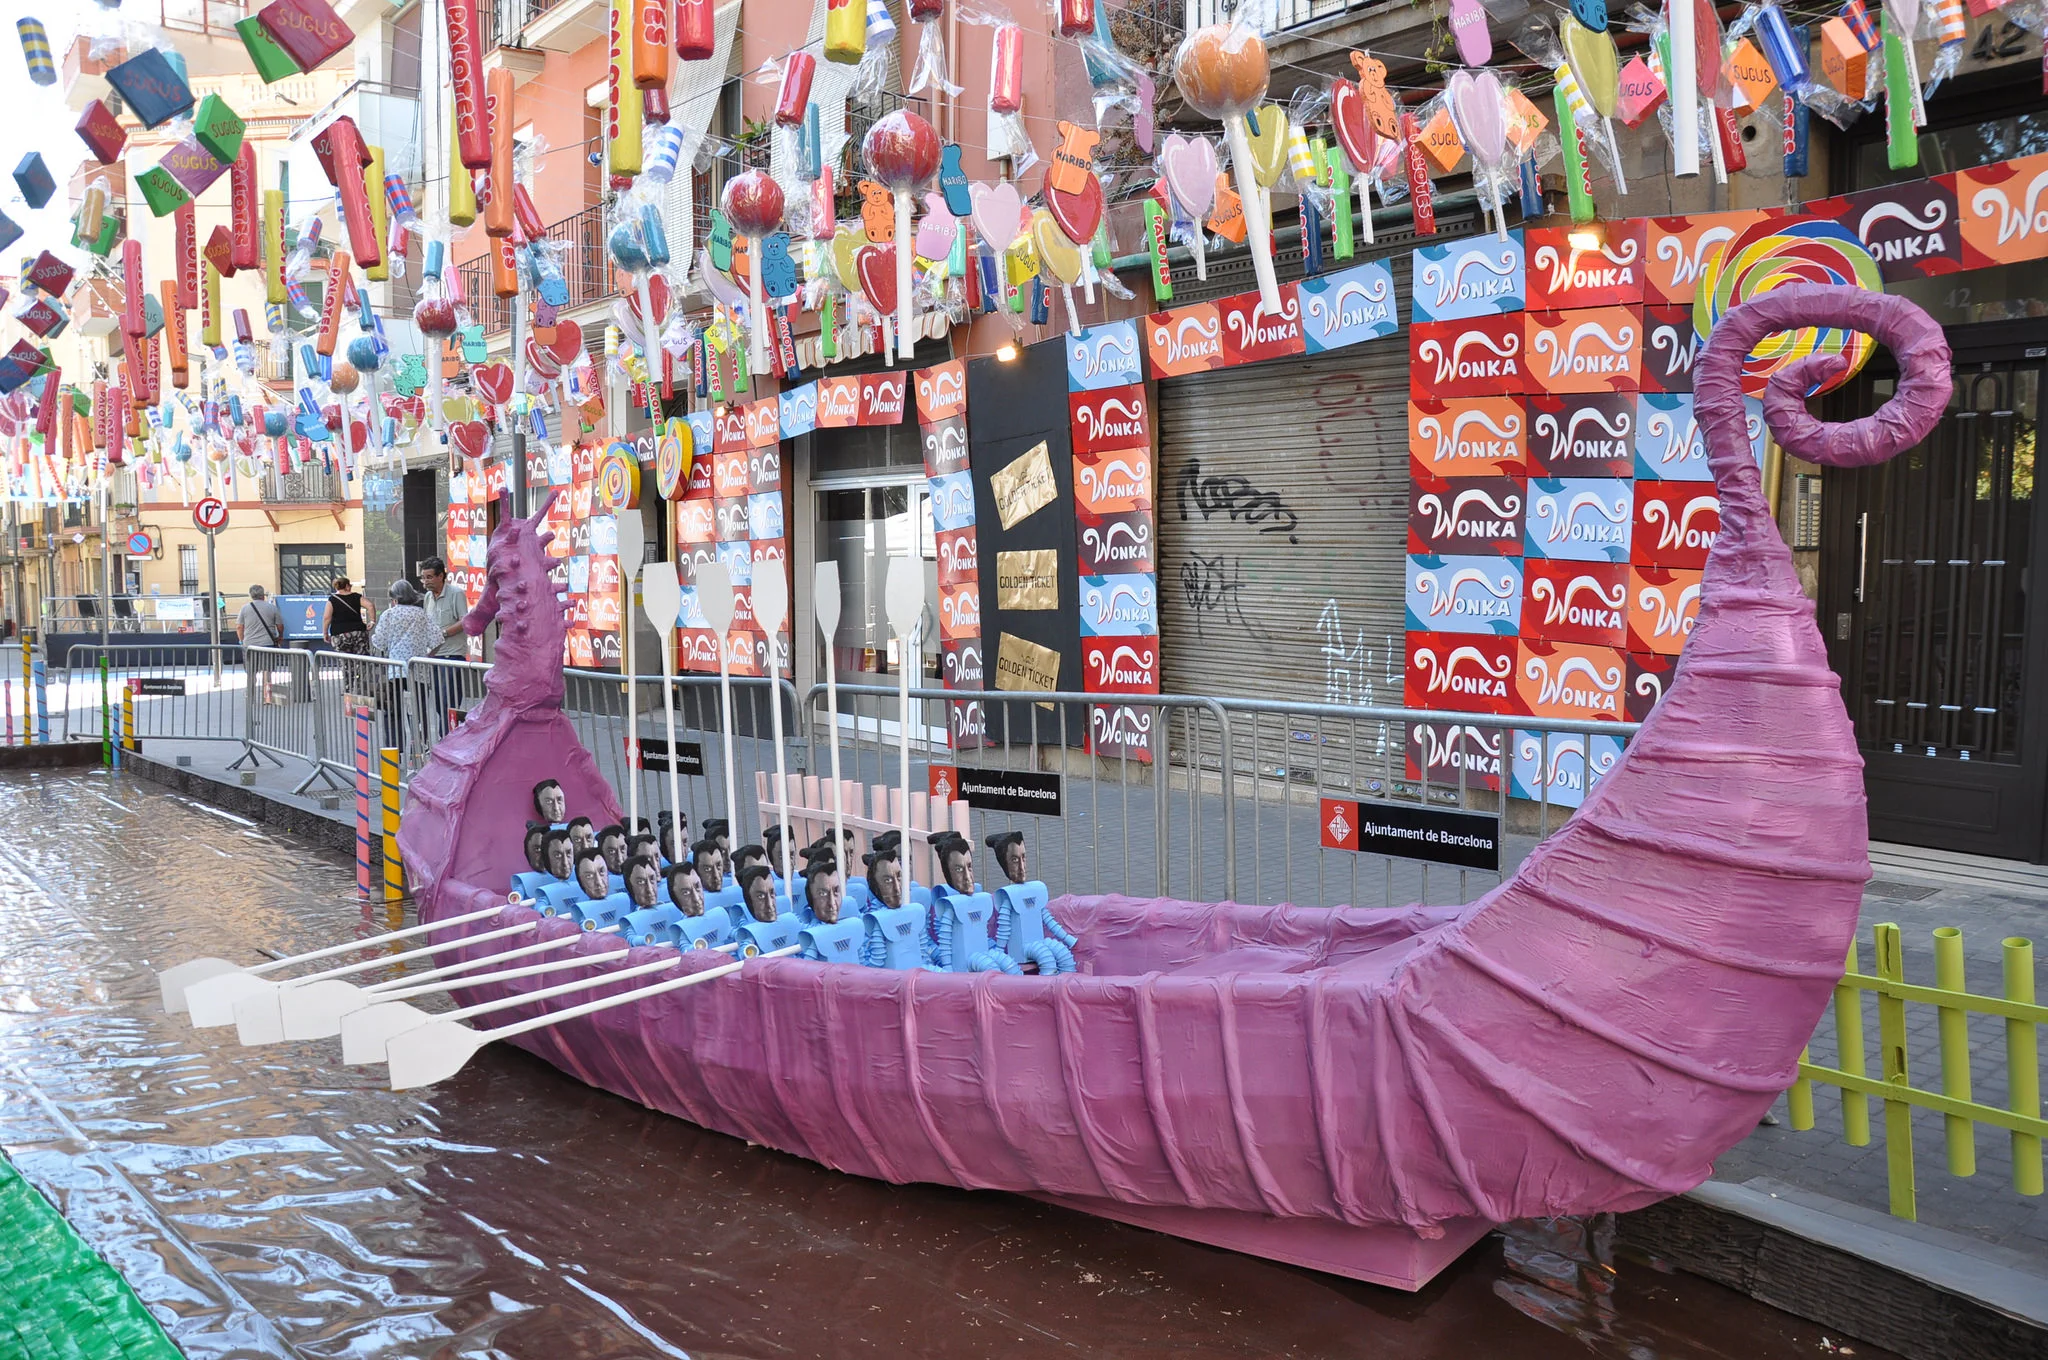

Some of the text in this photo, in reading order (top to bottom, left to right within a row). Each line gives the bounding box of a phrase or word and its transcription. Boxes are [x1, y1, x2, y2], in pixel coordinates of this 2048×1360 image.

[277, 8, 339, 39] SUGUS
[1454, 7, 1486, 29] HARIBO
[1972, 21, 2027, 60] 42
[122, 70, 182, 102] SUGUS
[447, 6, 475, 136] PALOTES
[1619, 81, 1653, 97] UGUS
[1733, 64, 1772, 84] SUGUS
[211, 120, 241, 138] SUGUS
[1430, 132, 1459, 147] SUGU
[171, 154, 218, 171] SUGUS
[1056, 150, 1092, 172] HARIBO
[151, 174, 182, 200] SUGUS
[942, 175, 967, 186] HARIBO
[233, 157, 250, 248] PALOTES
[1214, 202, 1243, 228] SUGUS
[712, 236, 732, 249] HARIBO
[920, 221, 957, 237] HARIBO
[184, 212, 198, 293] PALOTES
[735, 245, 749, 254] HAR
[1016, 247, 1036, 272] SUGUS
[1152, 215, 1171, 286] PALOTES
[1535, 239, 1638, 294] WONKA
[36, 264, 68, 279] SUGUS
[1423, 250, 1516, 307] WONKA
[320, 267, 341, 334] PALOTES
[1308, 278, 1388, 336] WONKA
[1944, 287, 1971, 309] 42
[780, 316, 795, 367] PALOTES
[1154, 316, 1219, 365] WONKA
[1227, 297, 1299, 350] WONKA
[149, 338, 159, 391] PALOTES
[707, 343, 721, 392] PALOTES
[1074, 335, 1135, 378] WONKA
[1419, 330, 1519, 384] WONKA
[1535, 322, 1634, 377] WONKA
[821, 384, 858, 416] WONKA
[864, 381, 904, 415] WONKA
[920, 371, 962, 411] WONKA
[98, 391, 106, 436] PALOTES
[717, 414, 745, 444] WONKA
[748, 406, 778, 438] WONKA
[783, 394, 815, 429] WONKA
[1077, 399, 1142, 441] WONKA
[691, 419, 712, 445] NKA
[926, 427, 966, 465] WONKA
[1418, 410, 1520, 462] WONKA
[1535, 407, 1630, 461] WONKA
[717, 459, 747, 488] WONKA
[751, 453, 779, 485] WONKA
[1080, 460, 1146, 503] WONKA
[718, 504, 748, 531] WONKA
[934, 481, 973, 520] WONKA
[1418, 489, 1520, 539] WONKA
[1535, 492, 1628, 544] WONKA
[681, 506, 712, 534] WONKA
[1643, 496, 1720, 550] WON
[941, 536, 977, 573] WONKA
[1083, 522, 1148, 563] WONKA
[591, 560, 618, 584] WONK
[1000, 575, 1055, 589] GOLDEN TICKET
[734, 593, 752, 620] ONKA
[943, 591, 980, 628] WONKA
[1087, 583, 1150, 625] WONKA
[1415, 568, 1515, 617] WONKA
[1532, 575, 1626, 629] WONKA
[683, 635, 717, 661] WONKA
[728, 637, 753, 664] WONKA
[757, 640, 788, 668] WKA
[1089, 645, 1153, 686] WONKA
[999, 657, 1054, 690] GOLDEN TICKET
[1414, 646, 1511, 697] WONKA
[1525, 656, 1621, 711] WONKA
[954, 701, 985, 738] WOK
[1094, 707, 1150, 747] WONKA
[643, 750, 669, 761] Ajuntamen
[1413, 724, 1500, 774] WONKA
[1520, 738, 1616, 790] WON
[962, 782, 1057, 800] Ajuntament de Barcelona
[1364, 820, 1493, 850] Ajuntament de Barcelona
